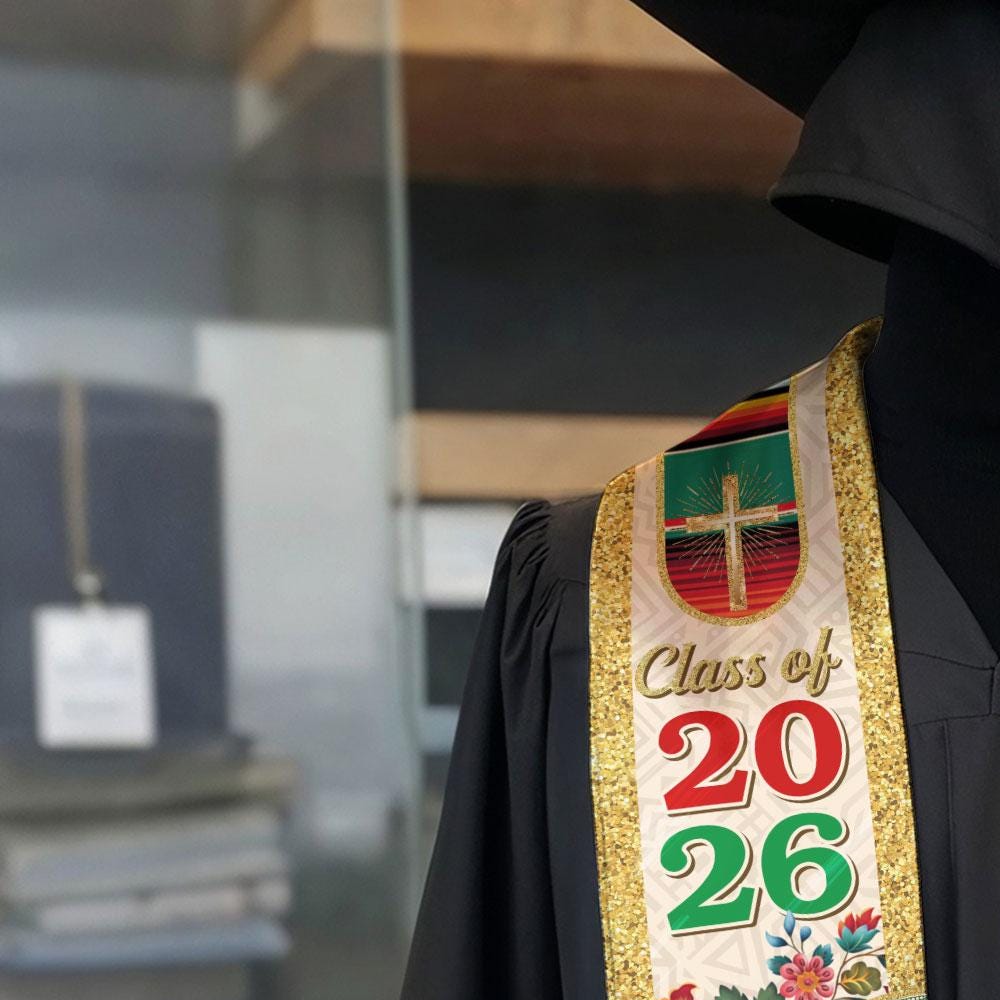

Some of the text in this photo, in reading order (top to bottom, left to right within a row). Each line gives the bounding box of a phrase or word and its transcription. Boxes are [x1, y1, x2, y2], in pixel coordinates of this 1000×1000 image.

[635, 626, 843, 699] Class of
[658, 700, 850, 816] 20
[660, 812, 859, 936] 26
